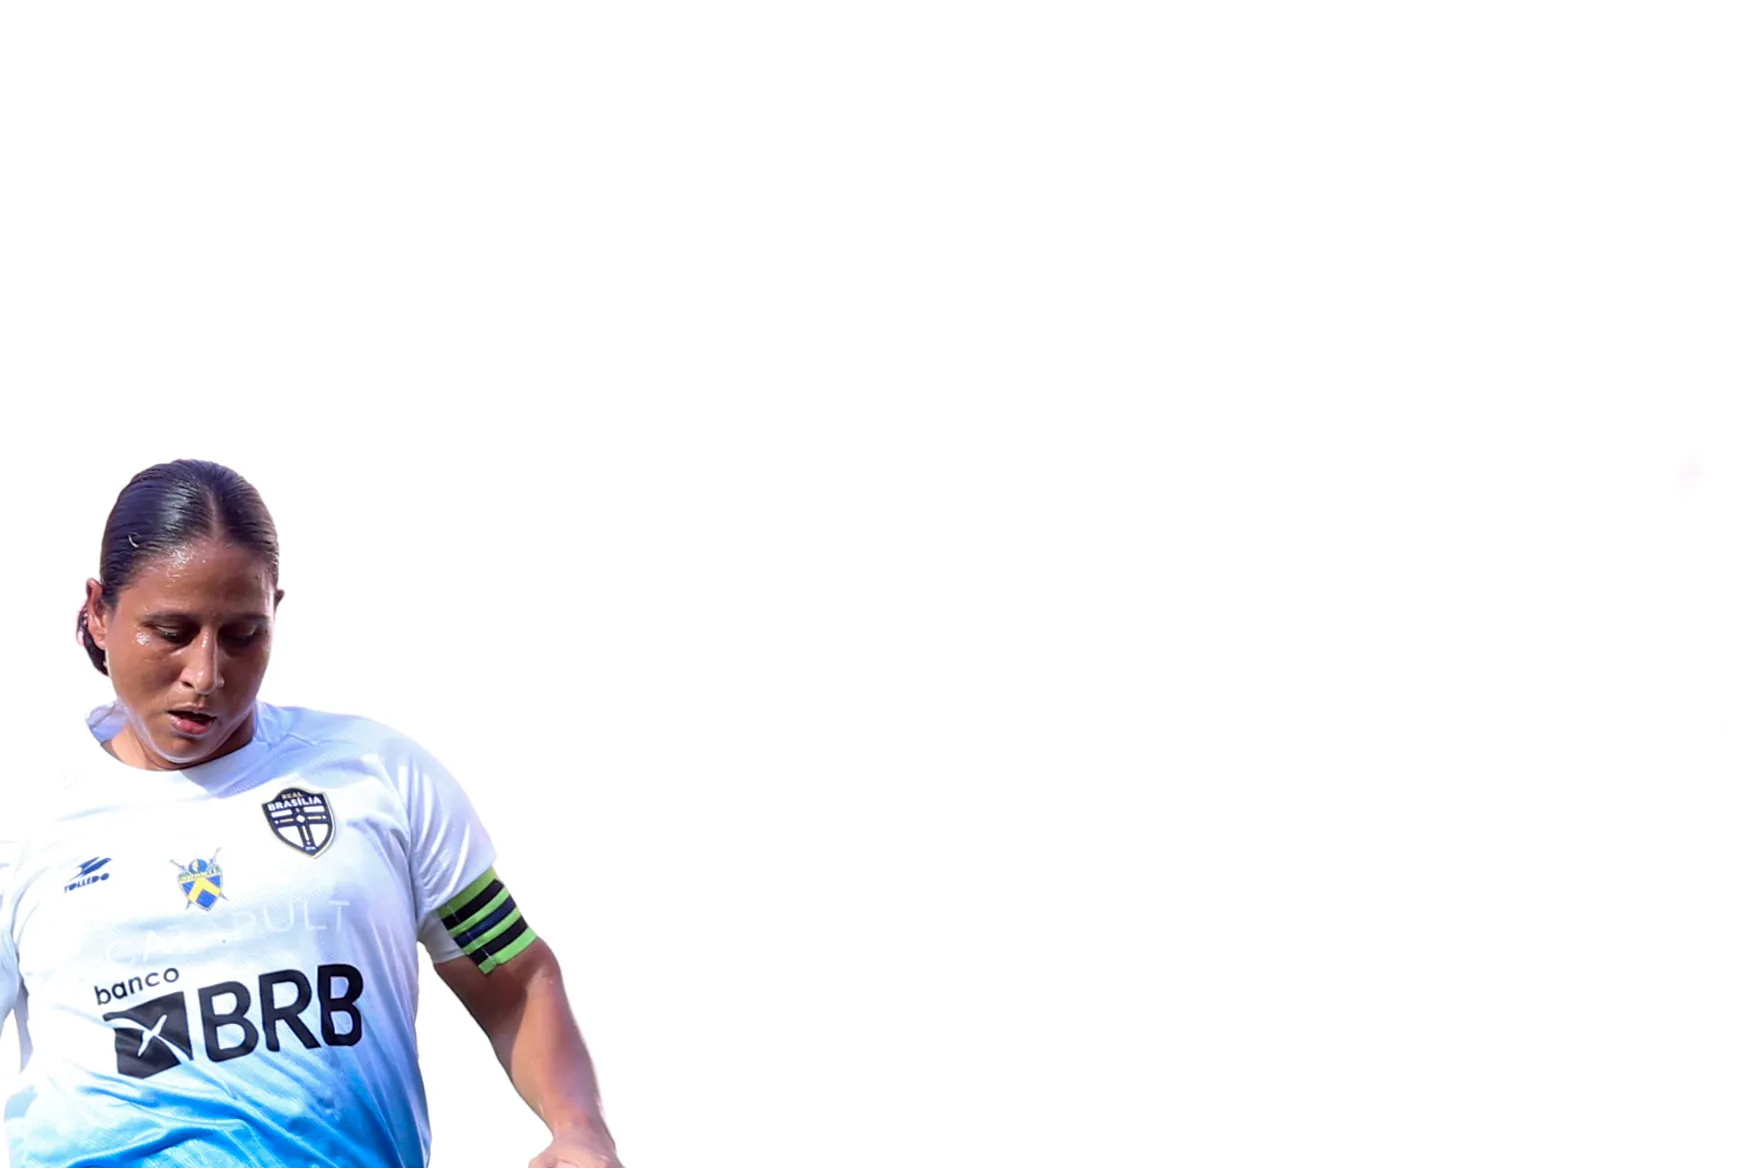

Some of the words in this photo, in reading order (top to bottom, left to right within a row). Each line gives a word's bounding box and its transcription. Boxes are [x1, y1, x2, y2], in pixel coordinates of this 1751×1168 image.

[267, 796, 322, 811] BRASÍLIA
[281, 791, 304, 800] REAL
[93, 967, 179, 1005] banco
[198, 963, 364, 1064] BRB
